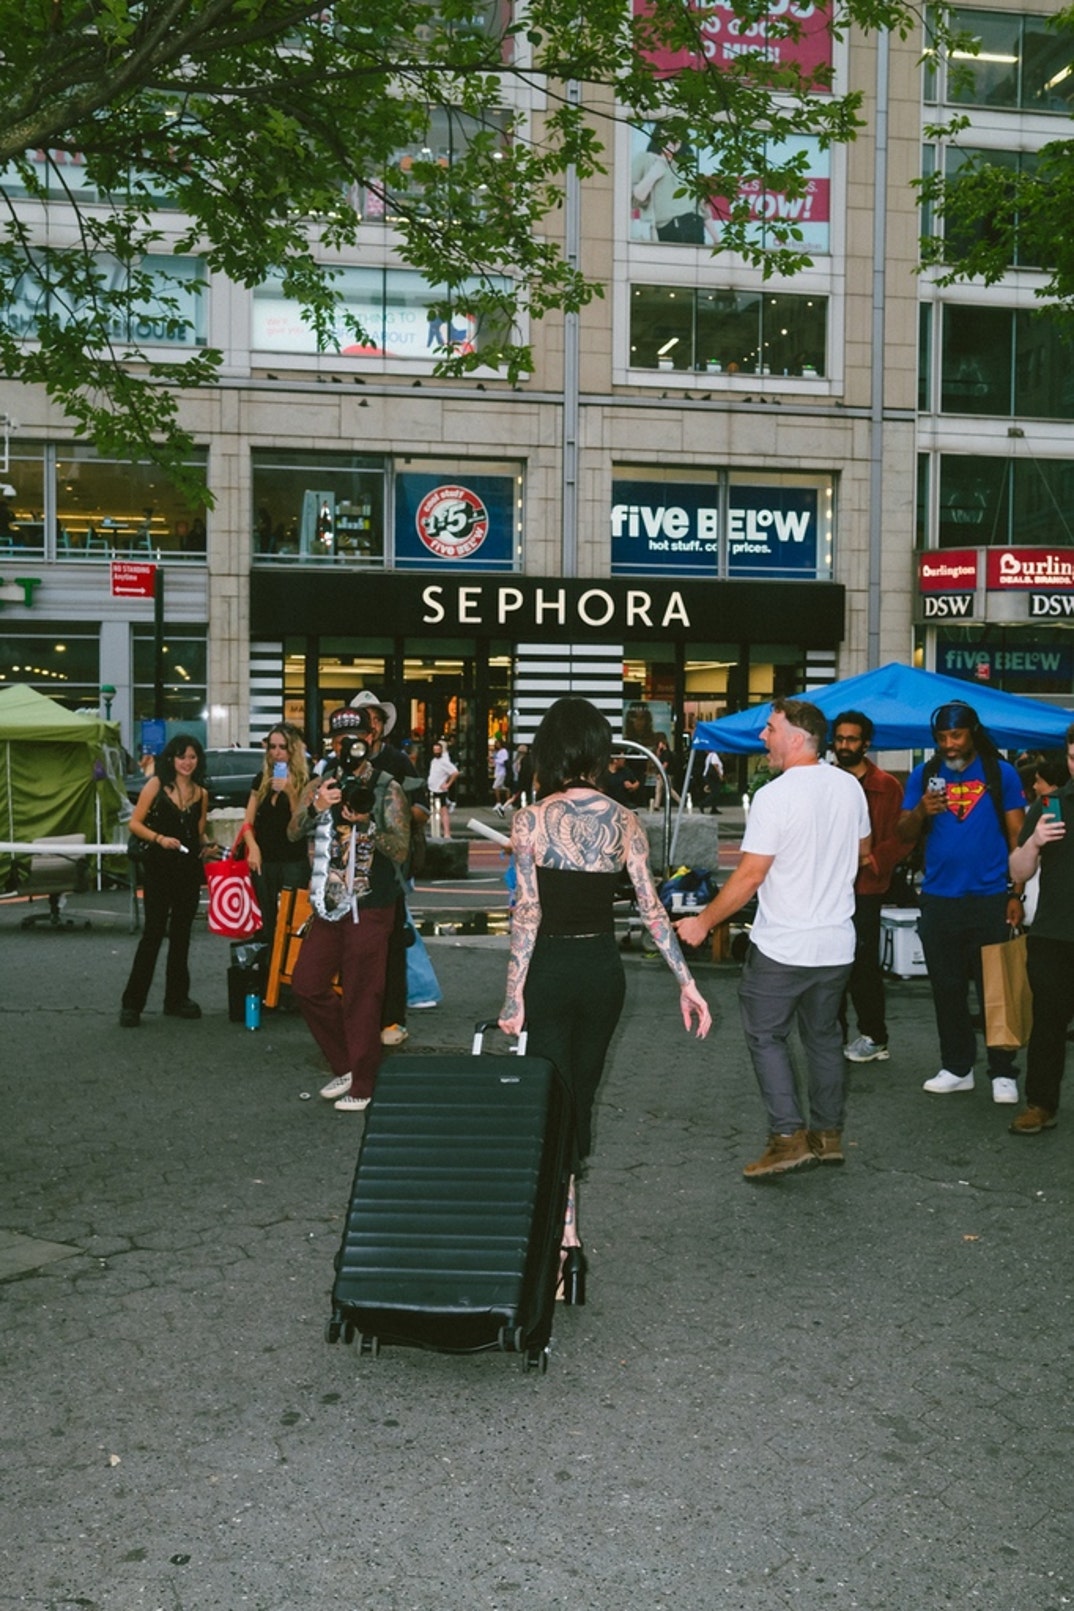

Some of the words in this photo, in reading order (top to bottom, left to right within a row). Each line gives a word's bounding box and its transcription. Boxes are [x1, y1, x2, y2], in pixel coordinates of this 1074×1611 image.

[611, 504, 690, 539] five
[697, 508, 811, 542] BELOW
[648, 540, 670, 551] hot
[671, 540, 703, 552] stuff.
[732, 543, 772, 555] prices.
[922, 564, 976, 579] Burlington
[1000, 553, 1074, 580] Burlin
[422, 585, 691, 627] SEPHORA
[925, 595, 972, 617] DSW
[945, 650, 990, 669] five
[994, 651, 1062, 671] BELOW
